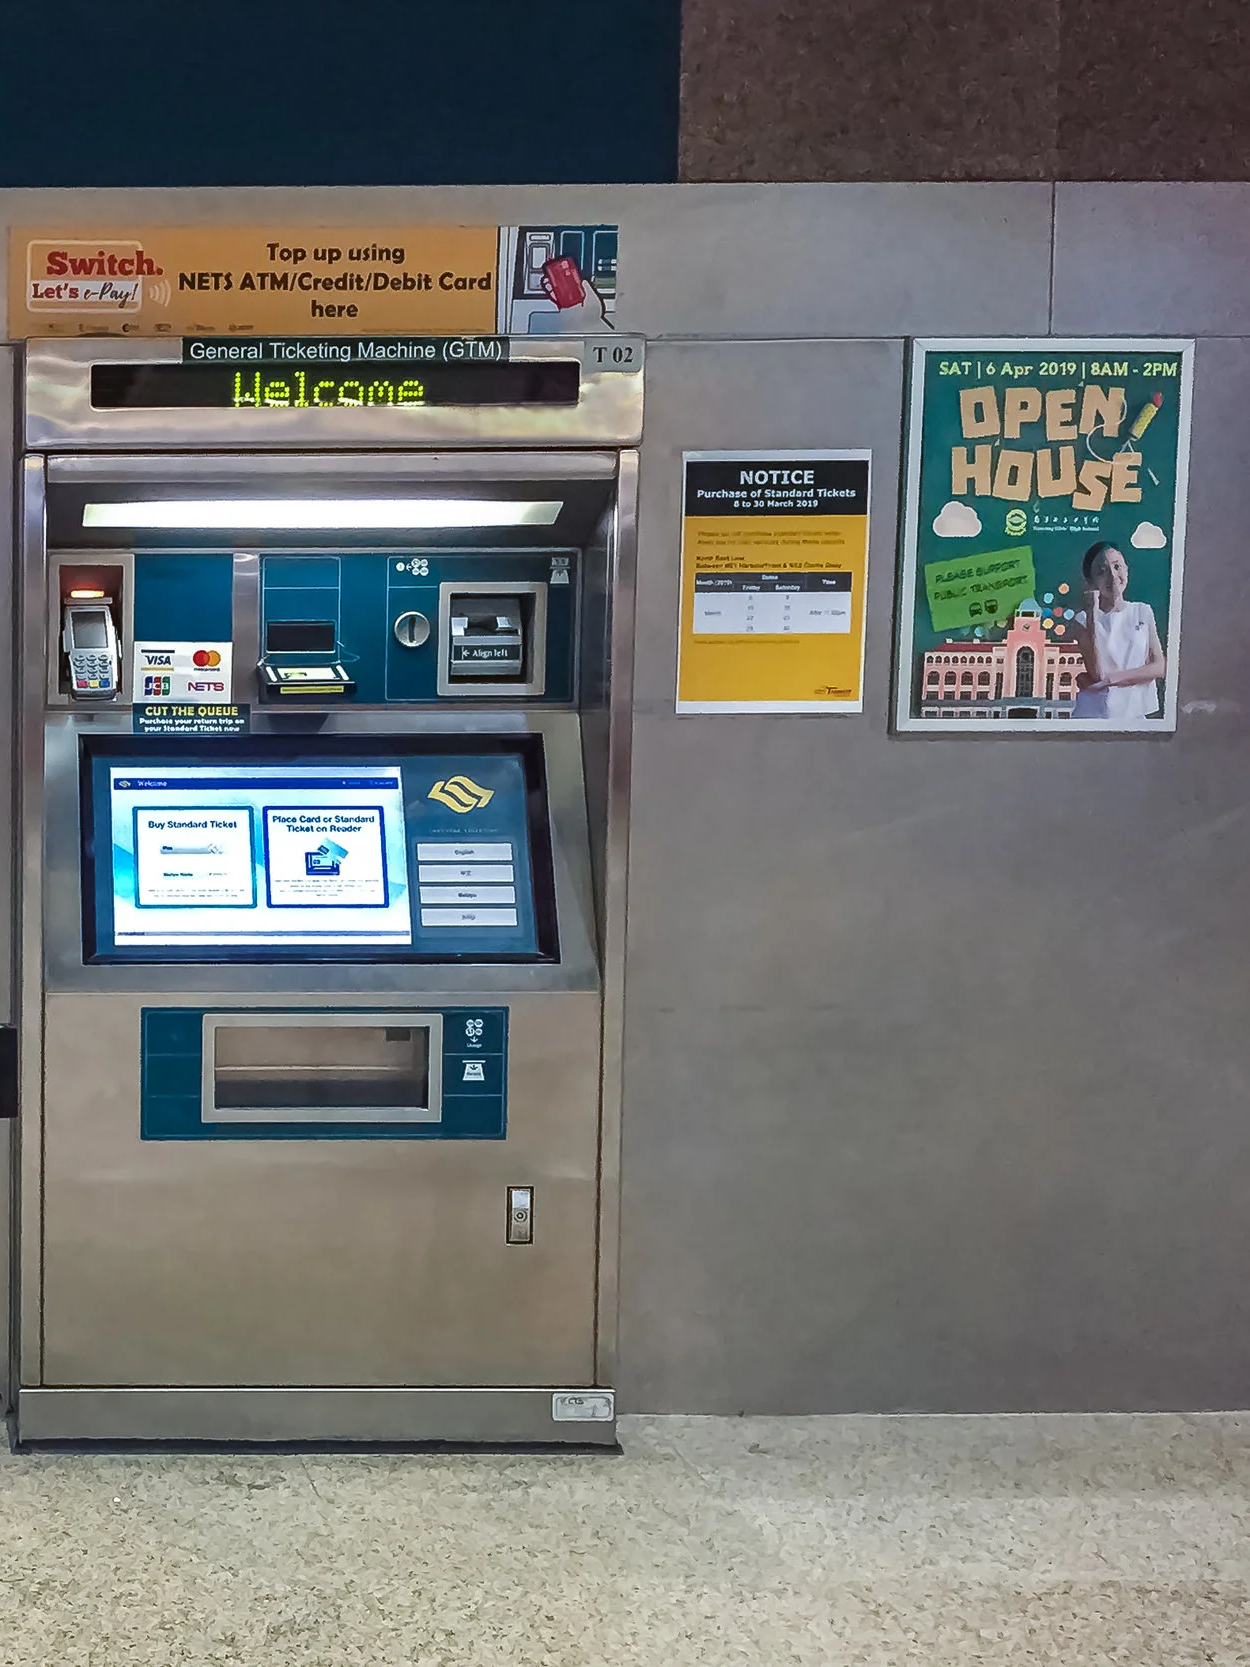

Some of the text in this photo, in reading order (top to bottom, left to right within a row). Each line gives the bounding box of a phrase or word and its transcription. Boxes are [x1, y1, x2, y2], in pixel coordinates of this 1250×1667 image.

[267, 243, 405, 264] Top up using
[46, 250, 164, 276] Switch.
[178, 272, 492, 293] NETS ATM/Credit/Debit Card
[32, 283, 79, 300] Let's
[311, 300, 359, 318] here
[190, 341, 502, 362] General Ticketing Machine (GTM)
[593, 346, 633, 364] T 02
[939, 362, 972, 376] SAT
[986, 362, 995, 375] 6
[1001, 362, 1033, 379] Apr
[1039, 362, 1076, 376] 2019
[1091, 362, 1128, 376] 8AM
[1143, 362, 1177, 377] 2PM
[234, 371, 424, 407] Welcome
[959, 385, 1126, 441] OPEN
[740, 470, 815, 485] NOTICE
[951, 445, 1142, 511] HOUSE
[697, 488, 856, 498] Purchase of Standard Tickets
[742, 500, 751, 508] to
[796, 500, 819, 508] 2019
[935, 568, 974, 583] PLEASE
[145, 655, 171, 665] VISA
[187, 682, 224, 691] NETS
[145, 707, 238, 717] CUT THE QUEUE
[219, 718, 232, 726] trip
[148, 820, 237, 829] Buy Standard Ticket
[272, 815, 297, 823] Place
[299, 815, 321, 823] Card
[334, 815, 375, 823] Standard
